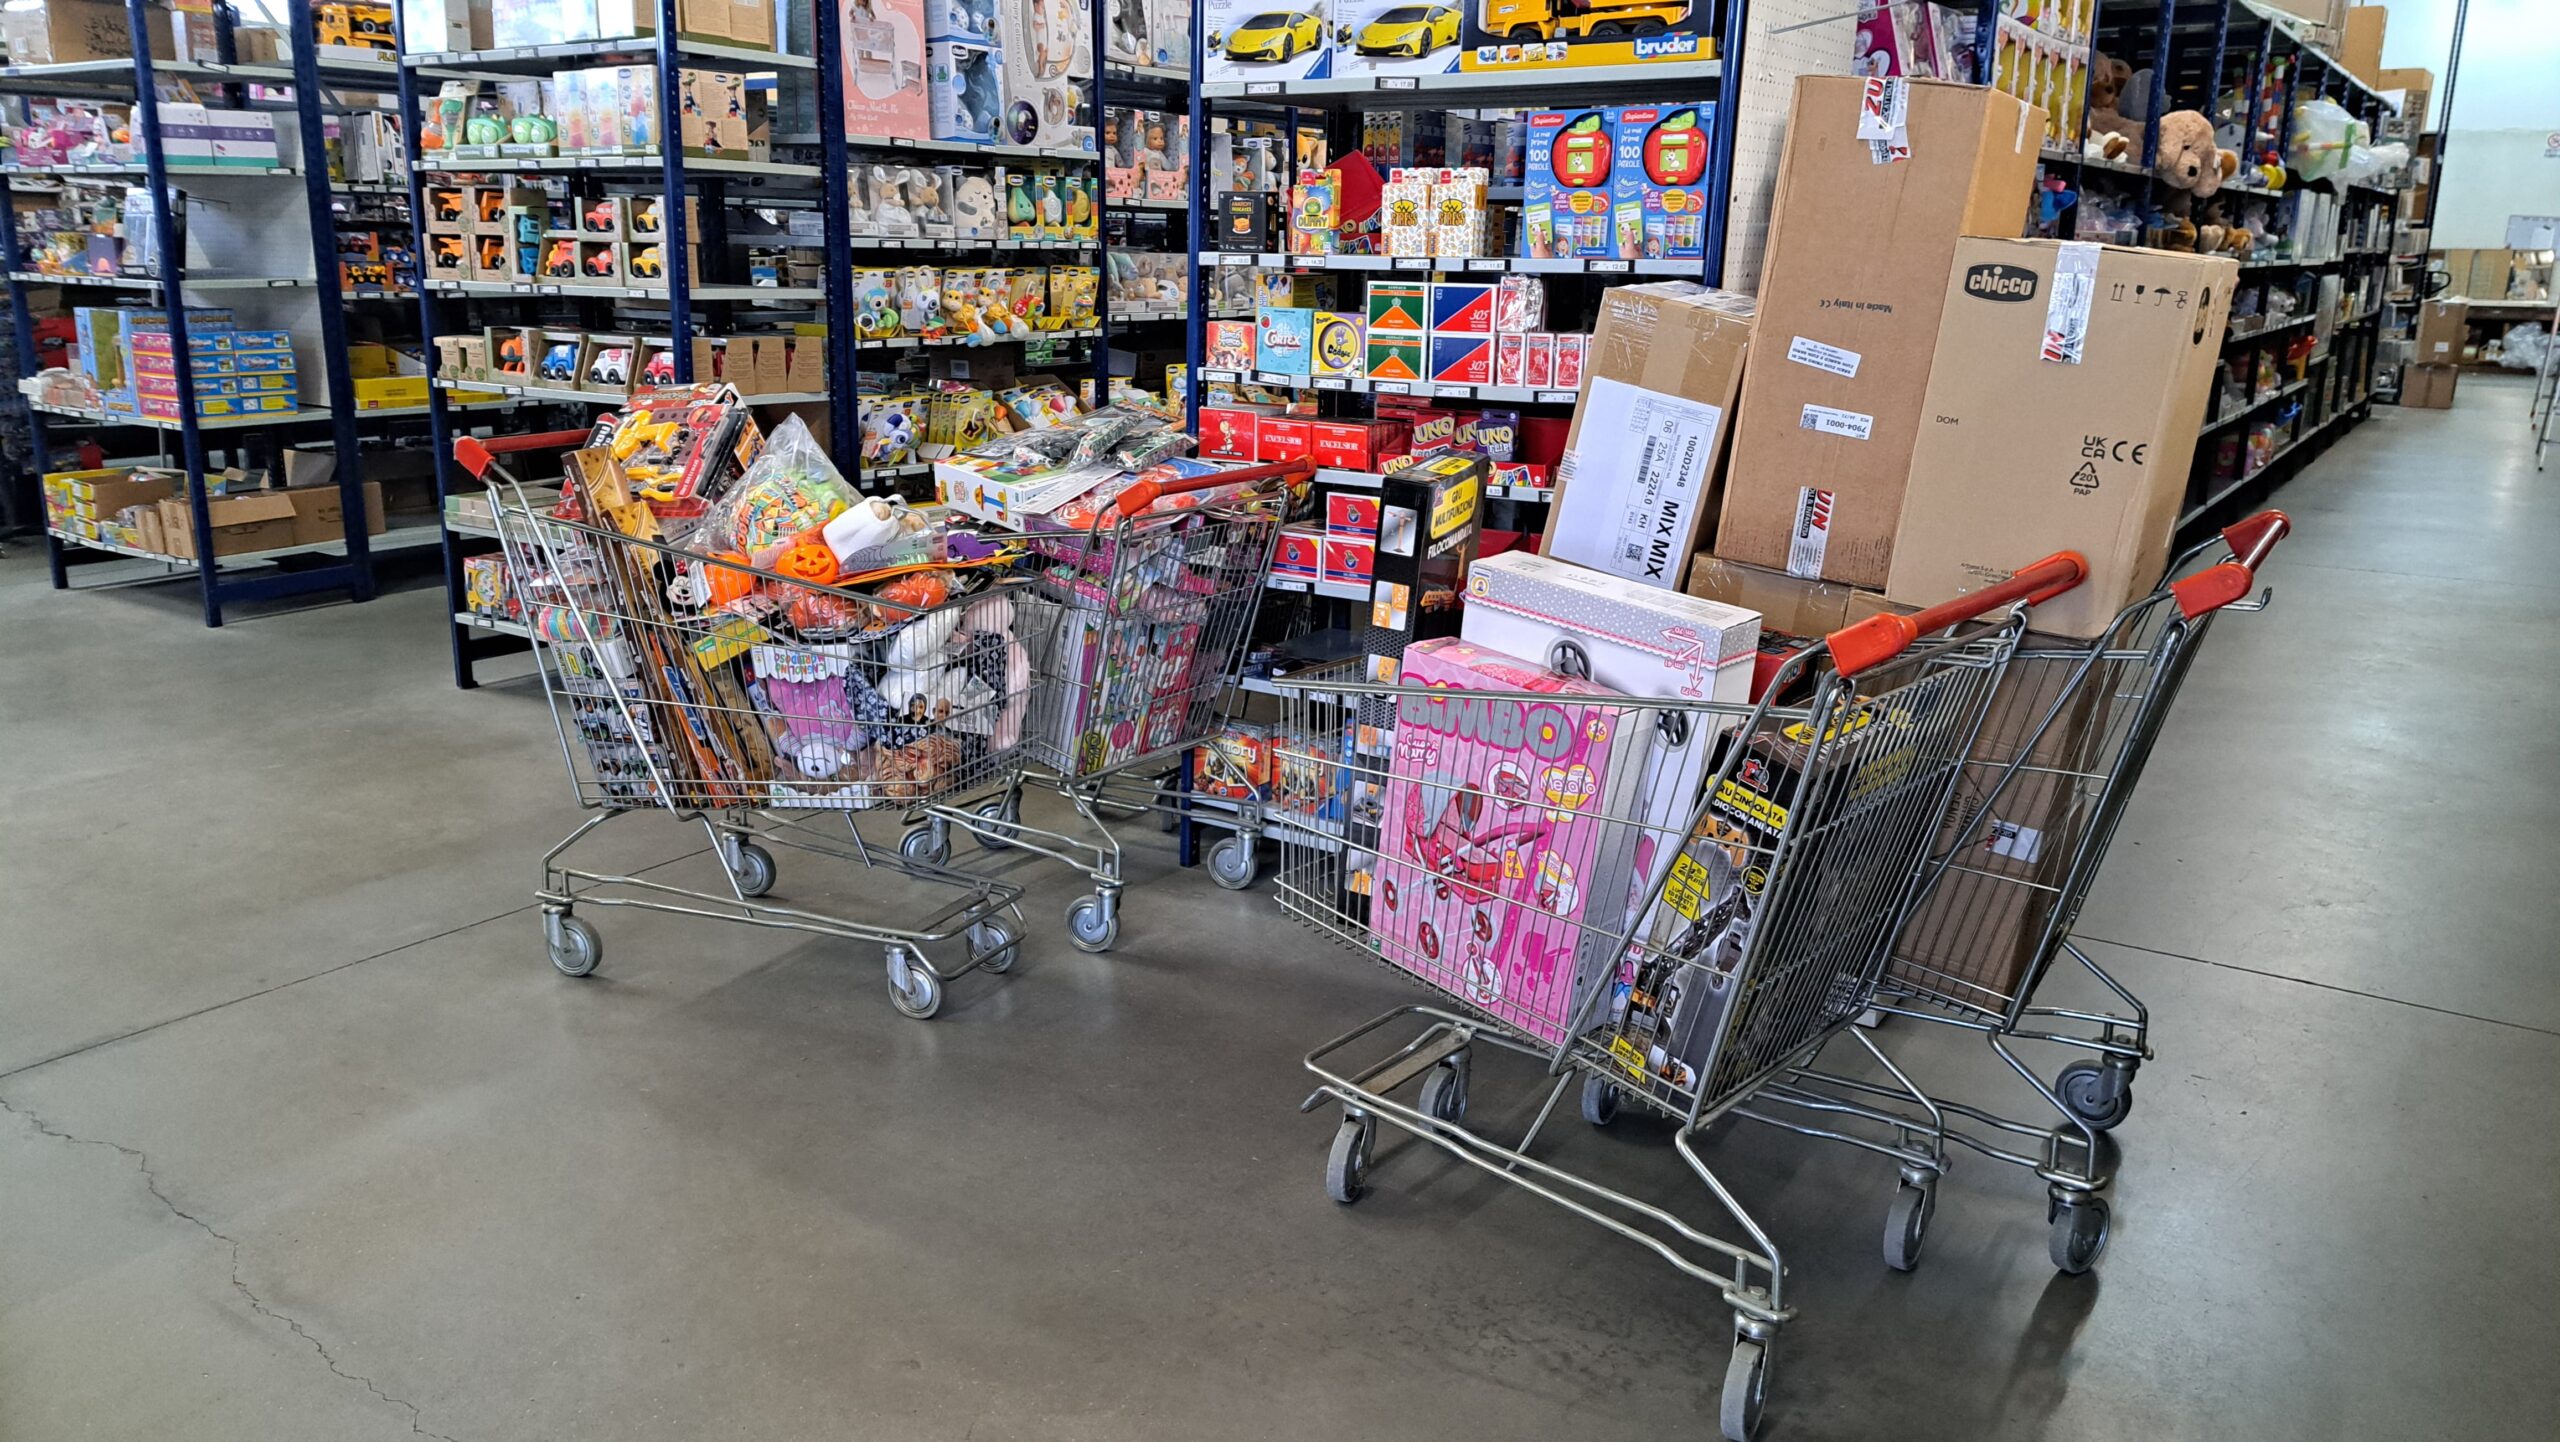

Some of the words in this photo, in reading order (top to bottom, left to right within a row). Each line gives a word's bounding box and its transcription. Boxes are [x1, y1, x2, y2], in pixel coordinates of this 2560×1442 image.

[1636, 37, 1695, 55] bruder
[1529, 150, 1549, 162] 100
[1619, 146, 1640, 158] 100
[1968, 266, 2034, 296] chicco
[1833, 298, 1853, 309] Italy
[1856, 302, 1864, 310] in
[1866, 302, 1894, 314] Made
[1469, 310, 1490, 320] 305
[1264, 329, 1302, 348] CORTEX
[1468, 360, 1490, 371] 305
[1662, 420, 1674, 434] 06
[1936, 416, 1959, 426] DOM
[1414, 416, 1455, 444] UNO
[1454, 420, 1478, 446] UN
[1477, 426, 1514, 446] UNO
[1264, 435, 1302, 445] EXCELSIOR
[1320, 440, 1358, 450] EXCELSIOR
[1654, 442, 1669, 462] 25A
[1380, 454, 1414, 476] UNO
[1676, 434, 1698, 488] 1002D2348
[2078, 473, 2094, 482] 20
[1451, 488, 1464, 504] GRU
[1643, 470, 1661, 505] 2224.0
[2072, 487, 2092, 497] PAP
[1434, 496, 1475, 530] MULTIFUNZIONE
[1637, 514, 1649, 529] KH
[1656, 500, 1680, 538] MIX
[1800, 506, 1812, 538] INFANZIA
[1427, 523, 1473, 560] FILOCOMANDATA
[1644, 540, 1670, 580] MIX
